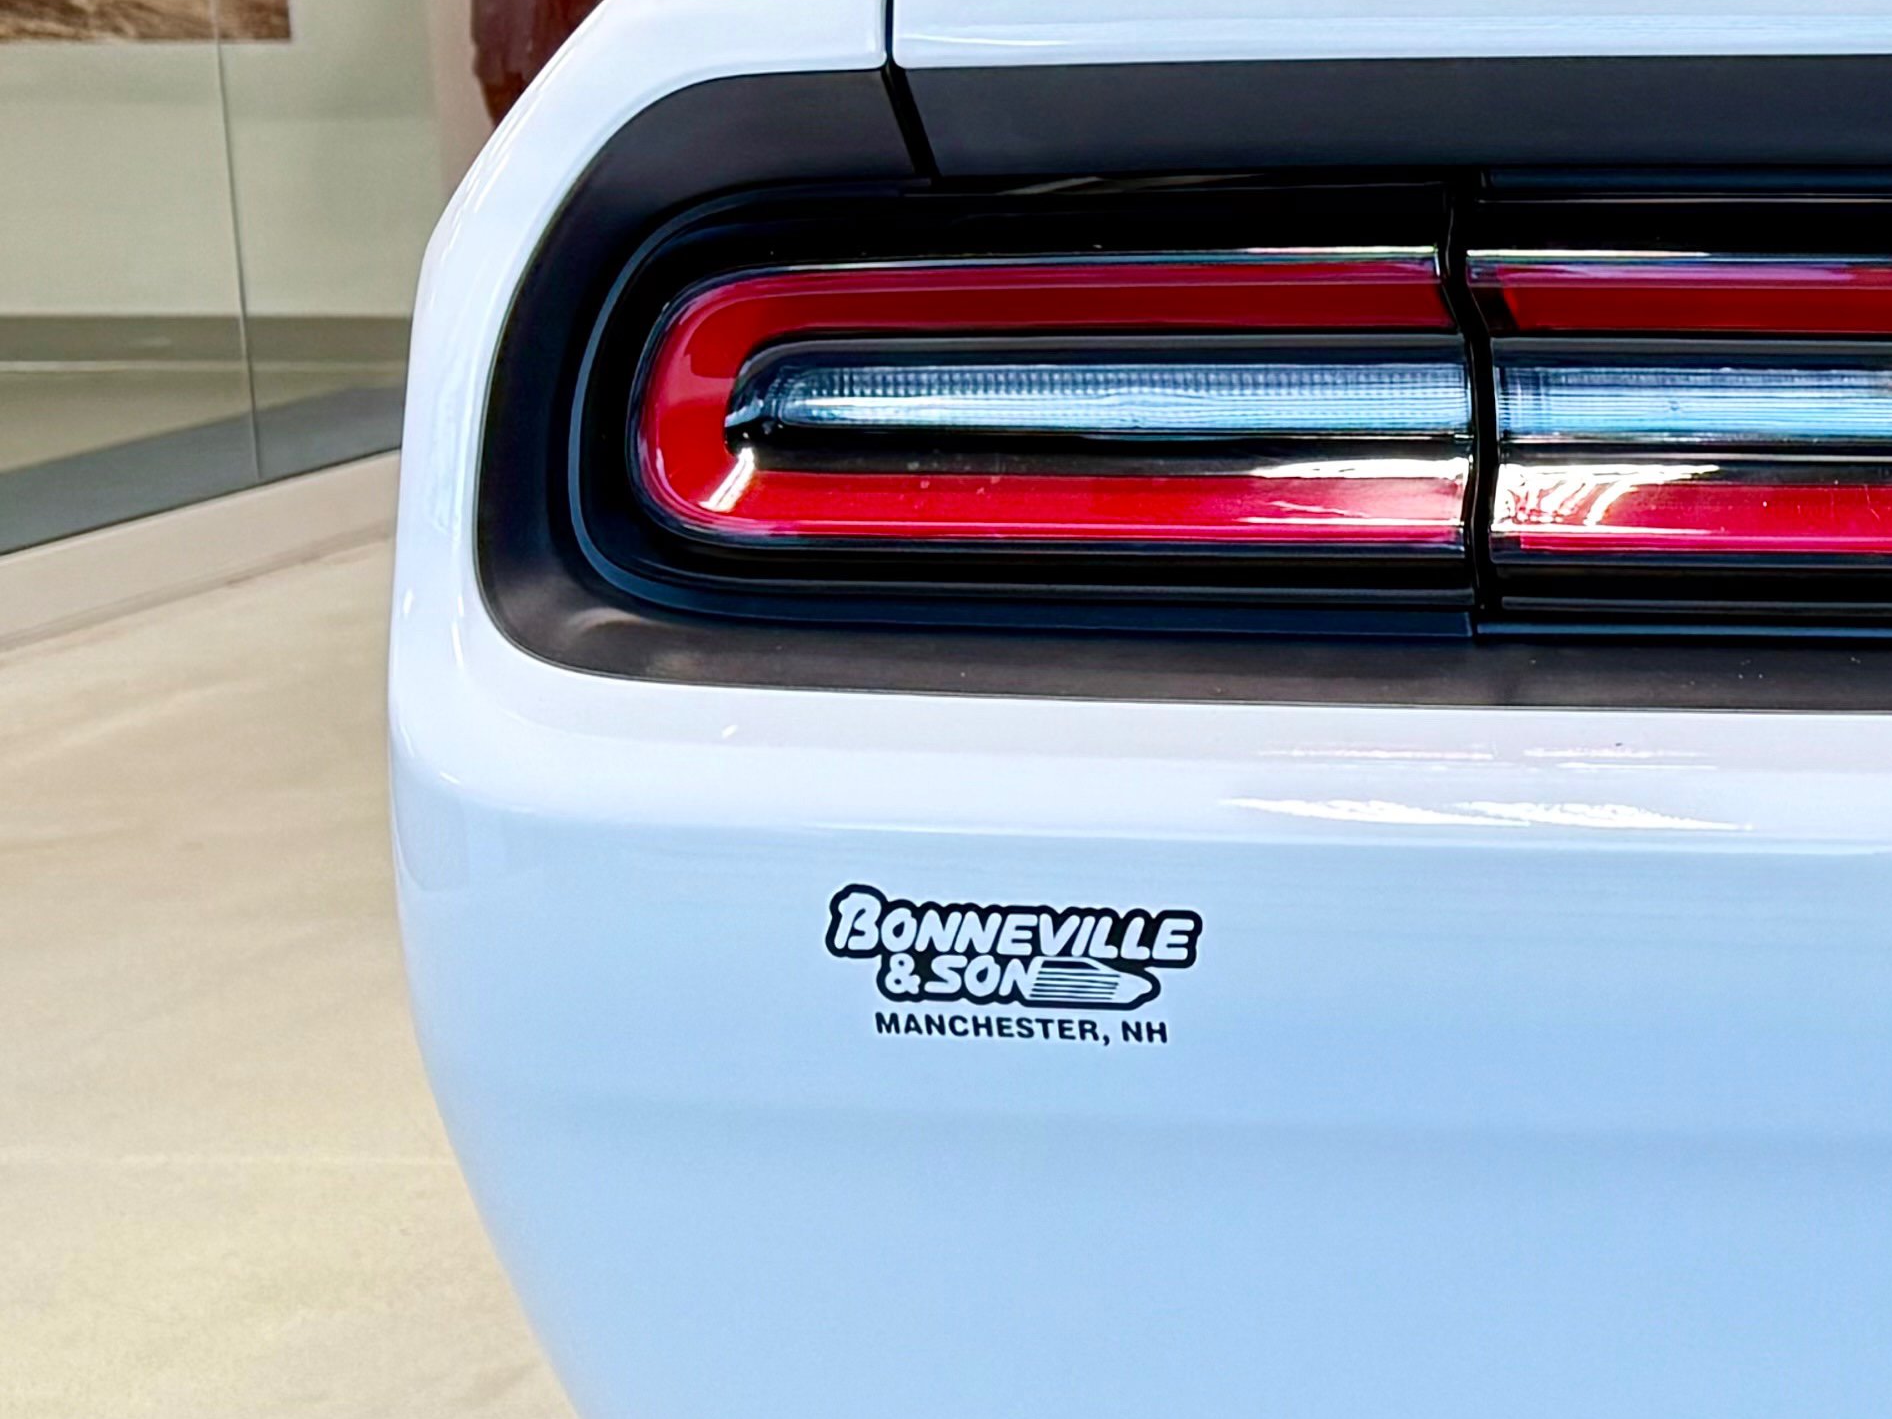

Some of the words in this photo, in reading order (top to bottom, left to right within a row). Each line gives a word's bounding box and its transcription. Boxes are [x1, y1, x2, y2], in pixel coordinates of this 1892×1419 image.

[829, 888, 1200, 965] BONNEVILLE
[883, 952, 921, 996] &
[923, 954, 1036, 998] SON
[873, 1011, 1111, 1046] MANCHESTER,
[1121, 1018, 1168, 1044] NH
